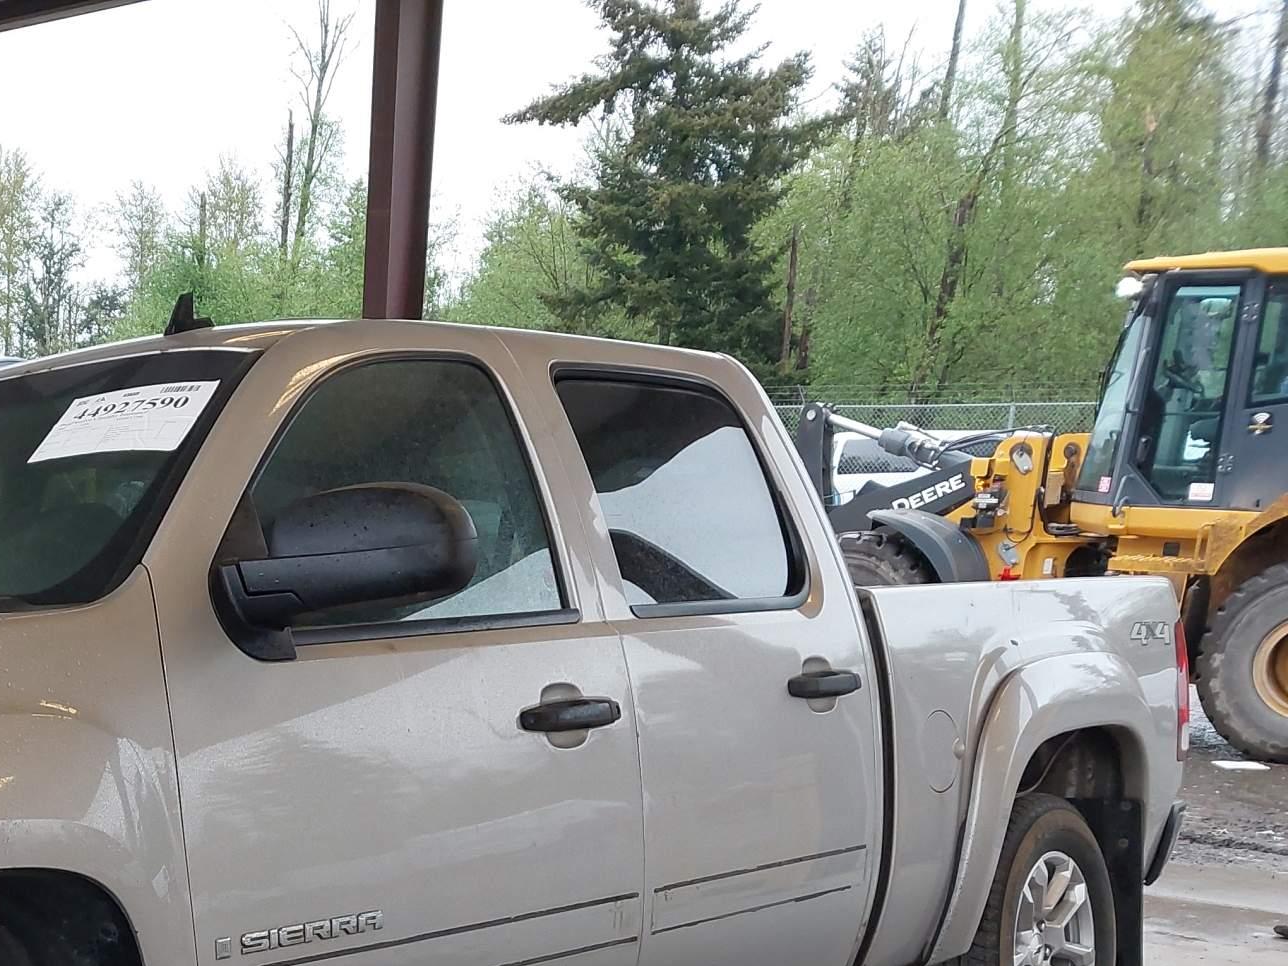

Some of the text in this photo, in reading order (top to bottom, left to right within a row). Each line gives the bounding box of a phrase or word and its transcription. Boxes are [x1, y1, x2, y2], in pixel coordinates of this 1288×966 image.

[73, 396, 189, 420] 44927590
[892, 472, 966, 510] DEERE
[240, 909, 384, 955] SIERRA
